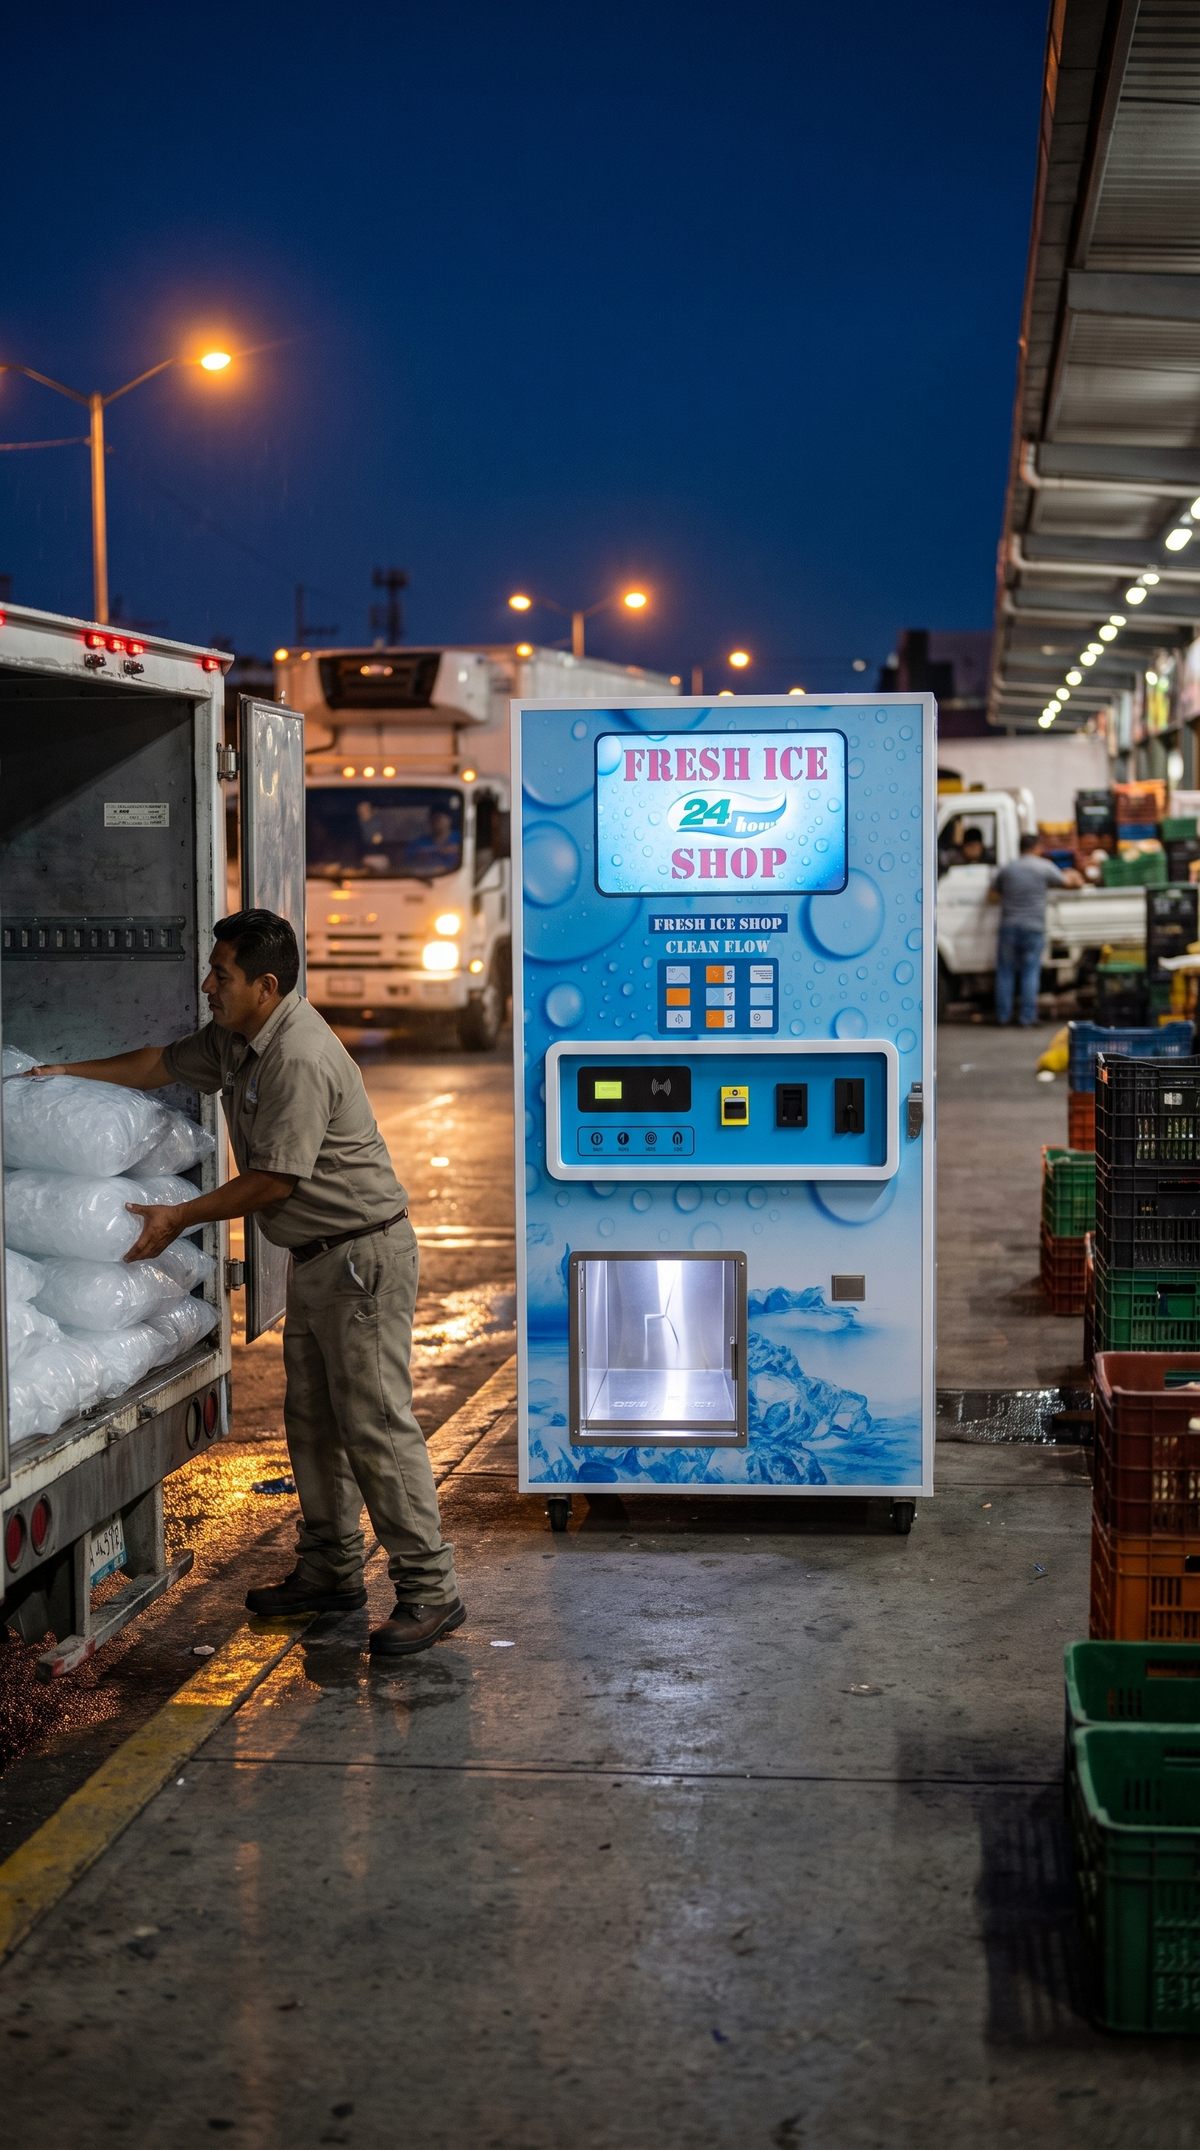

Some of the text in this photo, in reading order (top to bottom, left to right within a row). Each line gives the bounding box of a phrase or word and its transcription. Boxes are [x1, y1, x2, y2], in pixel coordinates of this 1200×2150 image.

[624, 746, 828, 782] FRESH ICE
[679, 798, 731, 826] 24
[671, 847, 788, 880] SHOP
[654, 917, 783, 931] FRESH ICE SHOP
[665, 939, 770, 954] CLEAN FLOW
